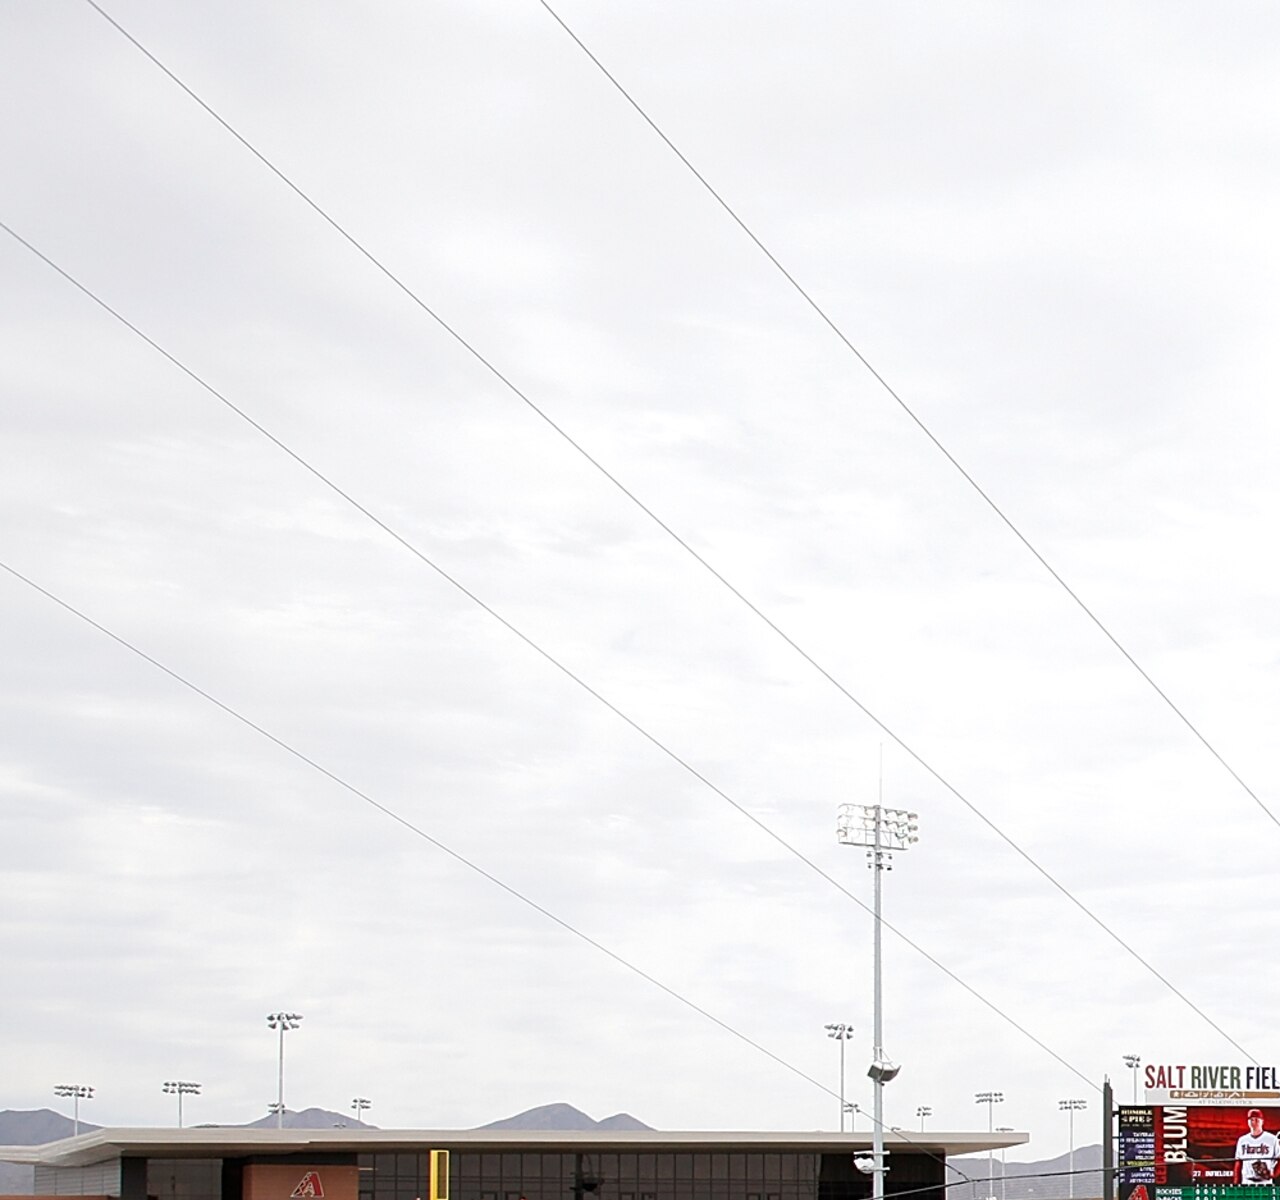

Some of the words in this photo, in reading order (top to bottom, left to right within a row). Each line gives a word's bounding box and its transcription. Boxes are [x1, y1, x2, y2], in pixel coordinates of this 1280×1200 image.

[1145, 1065, 1186, 1089] SALT
[1191, 1066, 1241, 1089] RIVER
[1163, 1106, 1187, 1163] BLUM
